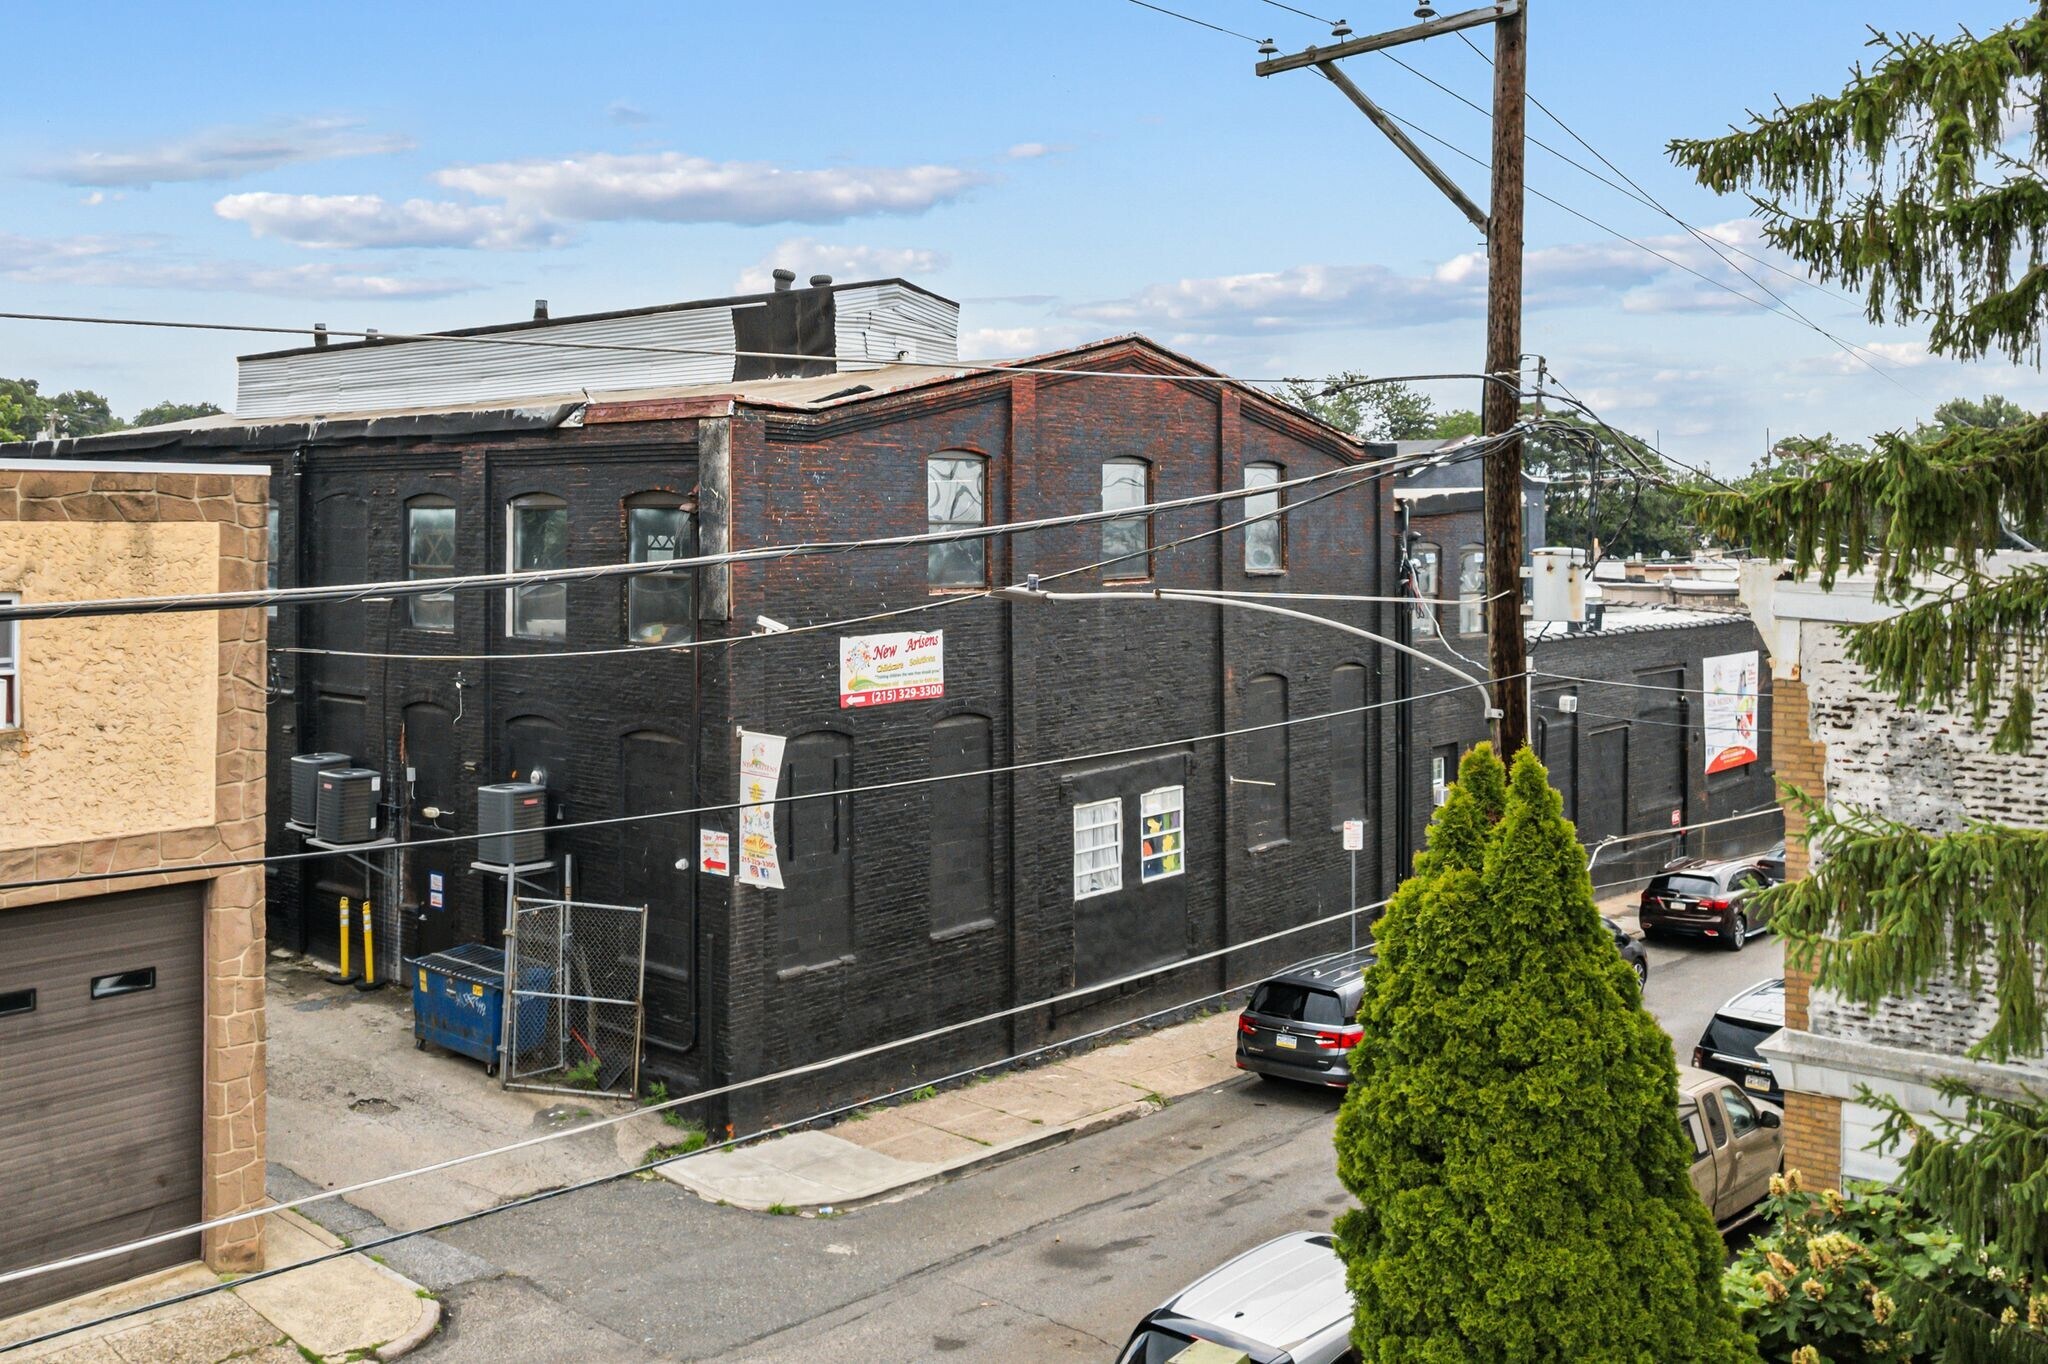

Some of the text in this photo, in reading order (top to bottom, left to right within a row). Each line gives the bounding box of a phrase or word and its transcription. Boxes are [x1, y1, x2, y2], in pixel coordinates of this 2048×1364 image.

[873, 635, 939, 660] New Arisens
[877, 655, 936, 673] Childcare Solutions
[871, 685, 943, 704] (215) 329-3300
